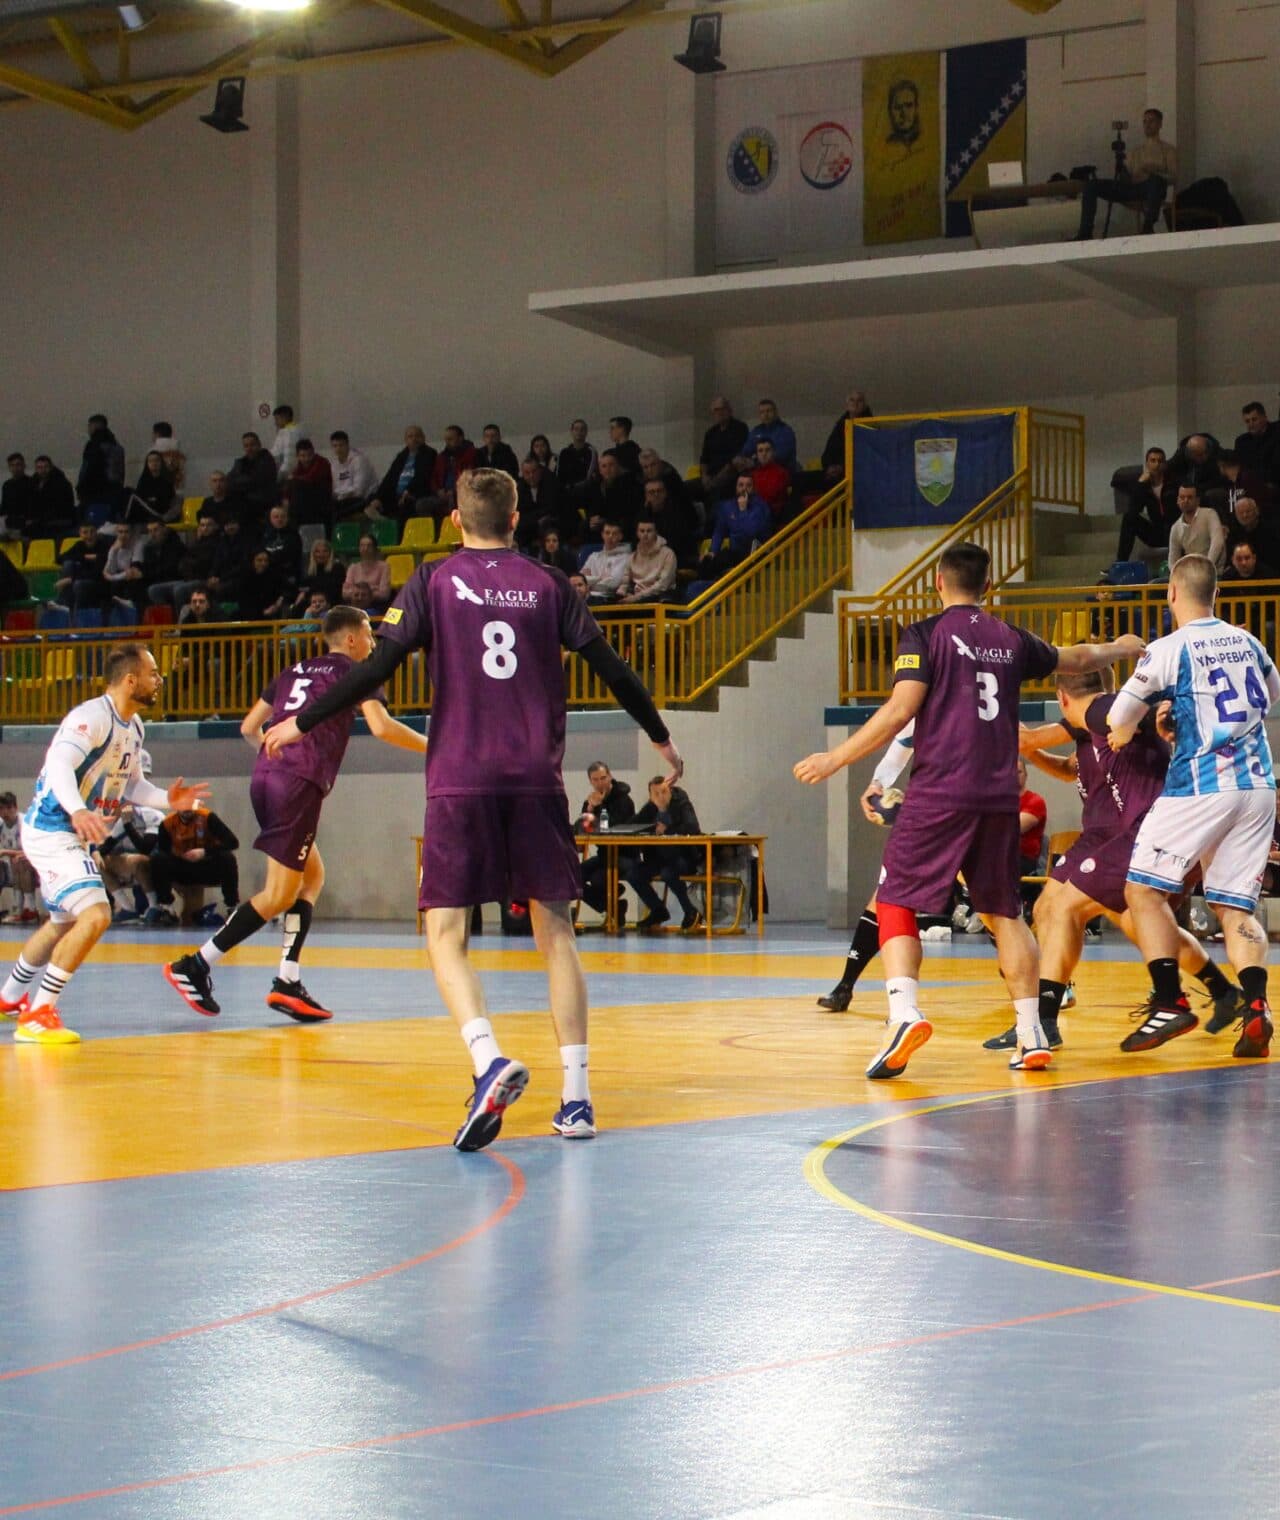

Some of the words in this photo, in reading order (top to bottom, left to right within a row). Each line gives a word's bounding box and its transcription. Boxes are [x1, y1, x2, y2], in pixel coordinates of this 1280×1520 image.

[484, 588, 538, 602] EAGLE
[484, 599, 537, 609] TECHNOLOGY
[482, 620, 518, 680] 8
[283, 678, 314, 711] 5
[976, 671, 1000, 722] 3
[1207, 666, 1268, 723] 24
